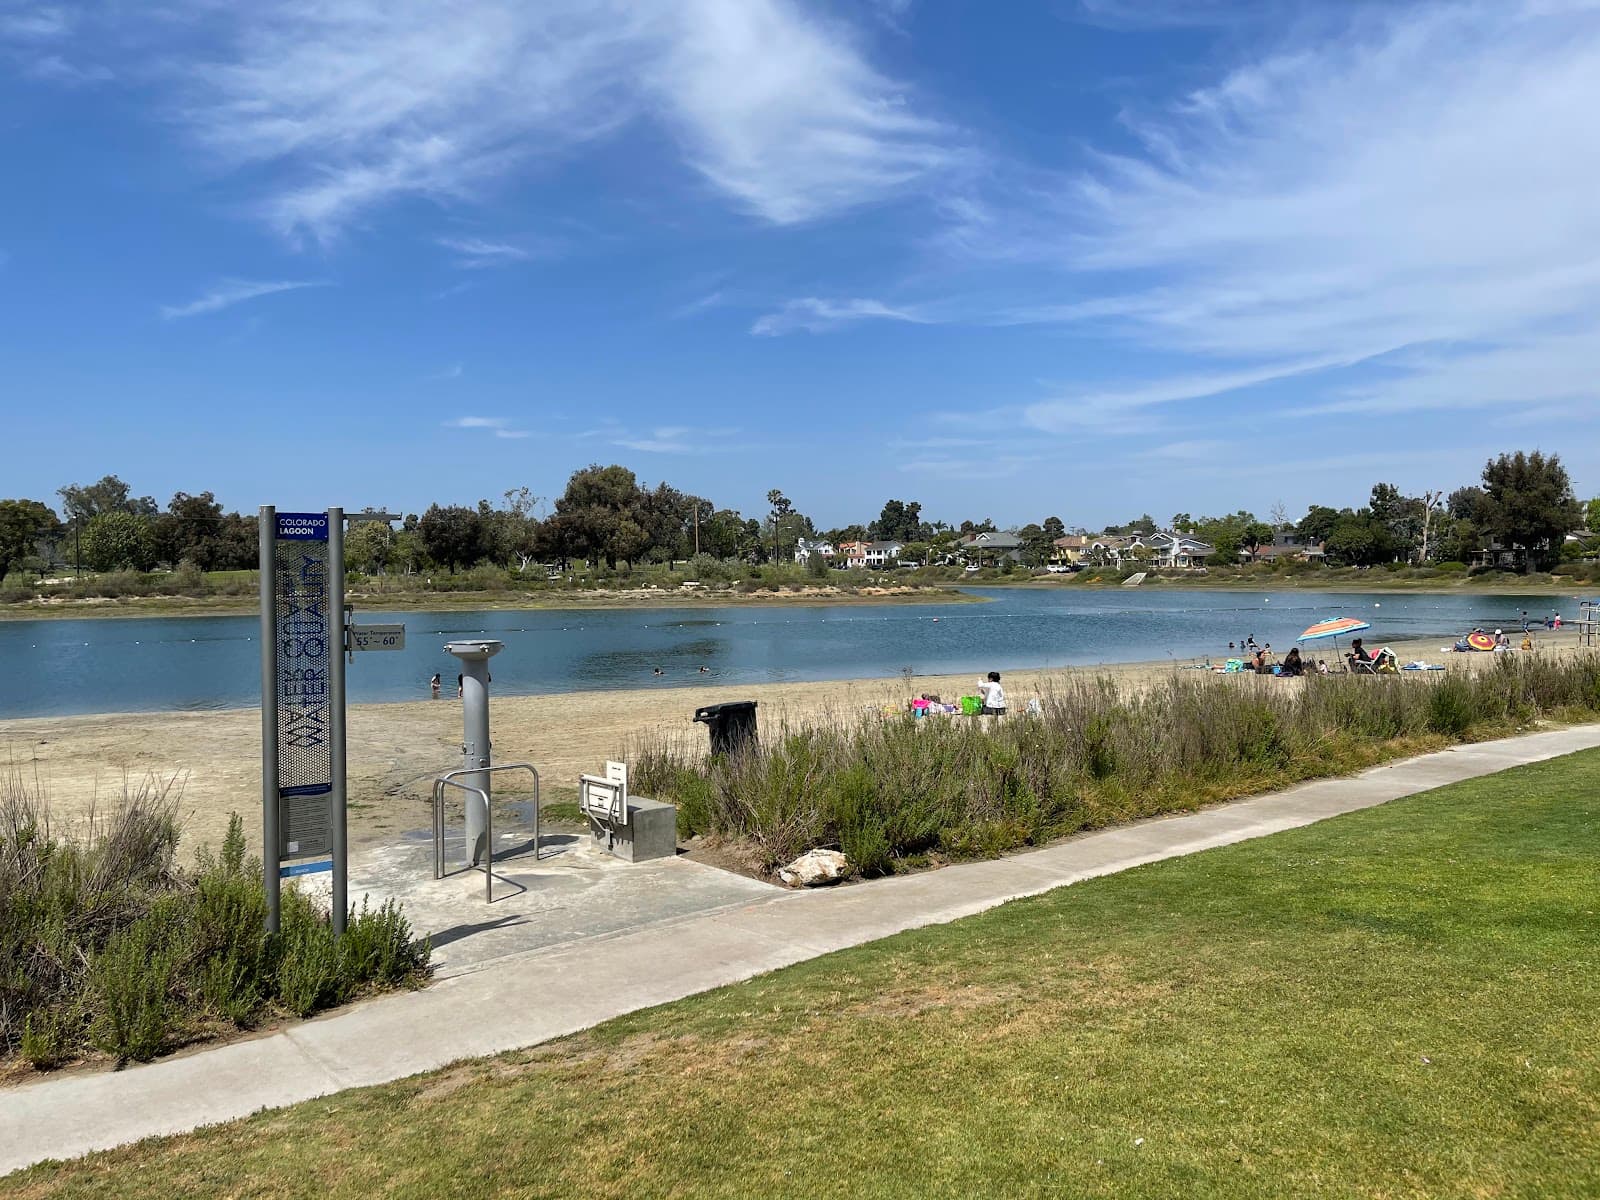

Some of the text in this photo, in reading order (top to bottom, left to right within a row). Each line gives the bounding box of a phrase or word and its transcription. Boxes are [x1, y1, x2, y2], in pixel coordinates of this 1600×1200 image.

[279, 518, 326, 527] COLORADO
[279, 527, 314, 535] LAGOON
[383, 636, 399, 646] 60°
[301, 555, 325, 748] WATER QUALITY
